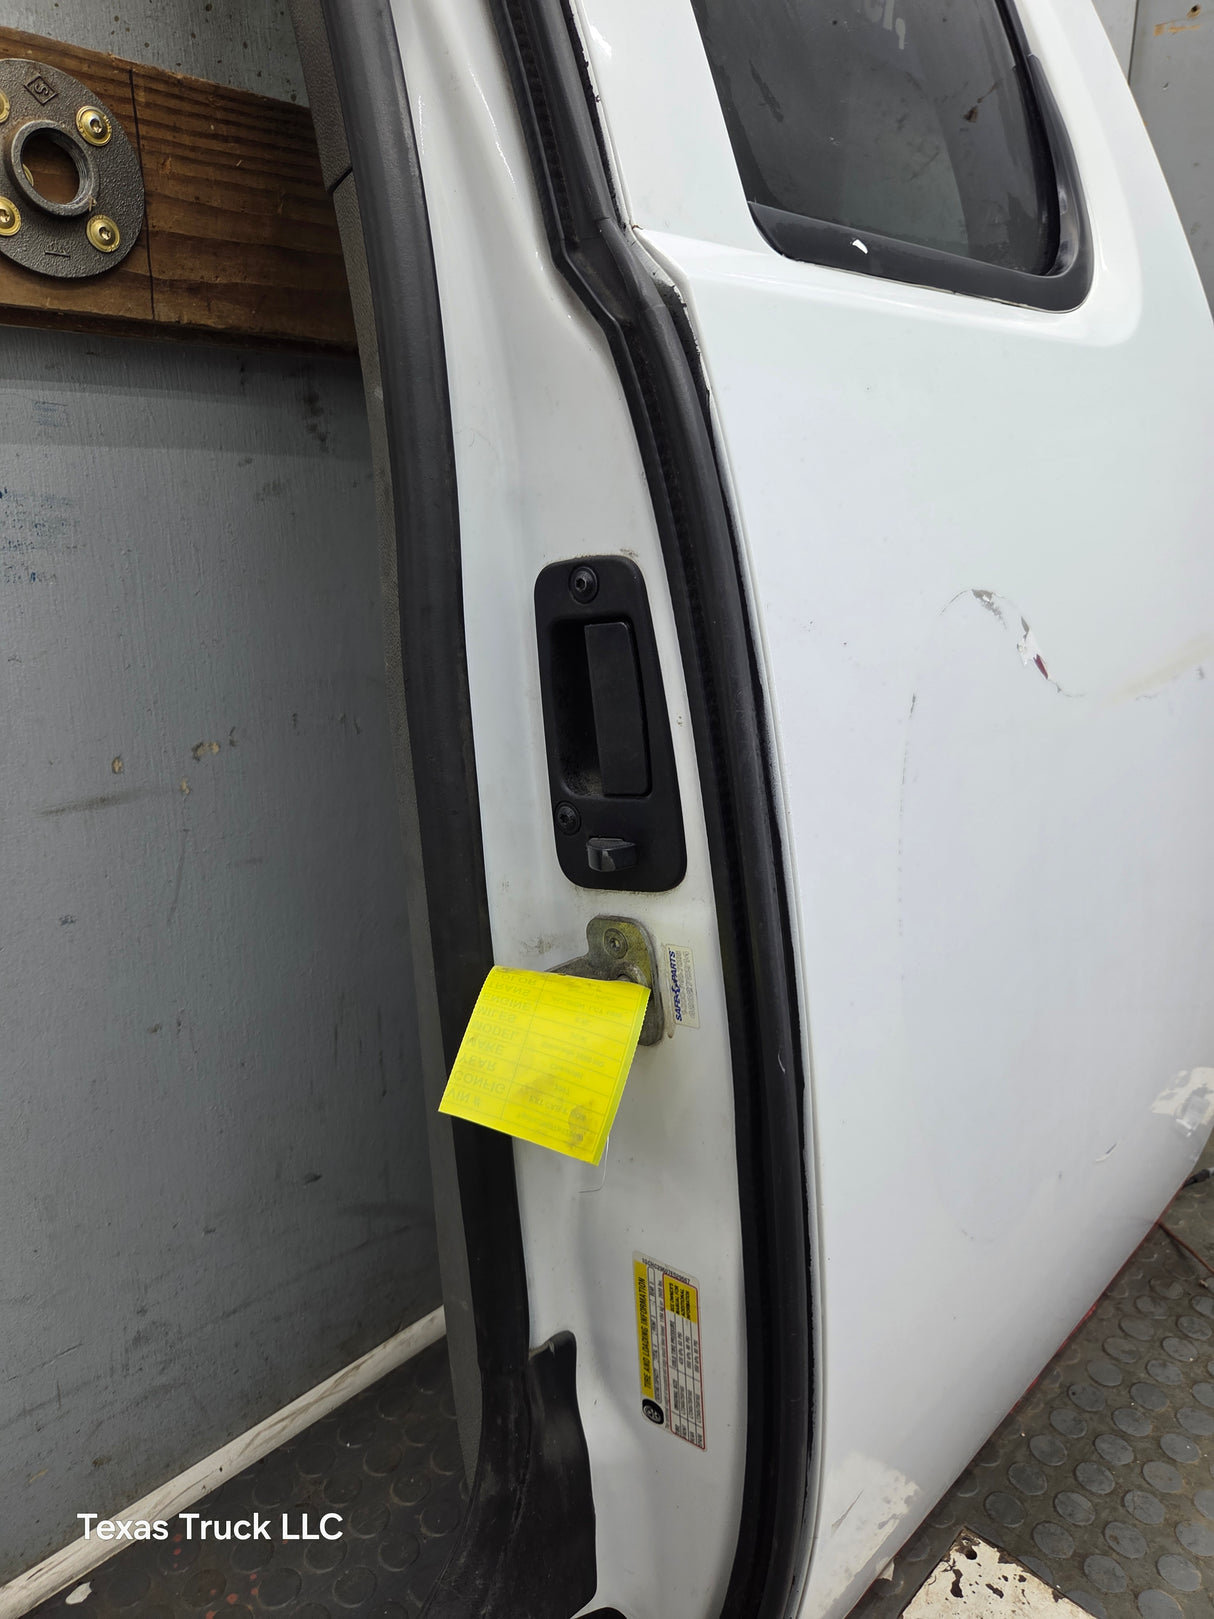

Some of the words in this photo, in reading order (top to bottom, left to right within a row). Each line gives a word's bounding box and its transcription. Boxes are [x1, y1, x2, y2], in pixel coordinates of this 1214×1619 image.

[638, 1276, 647, 1325] INFORMATION
[640, 1325, 649, 1357] LOADING
[642, 1356, 650, 1373] AND
[643, 1372, 651, 1390] TIRE
